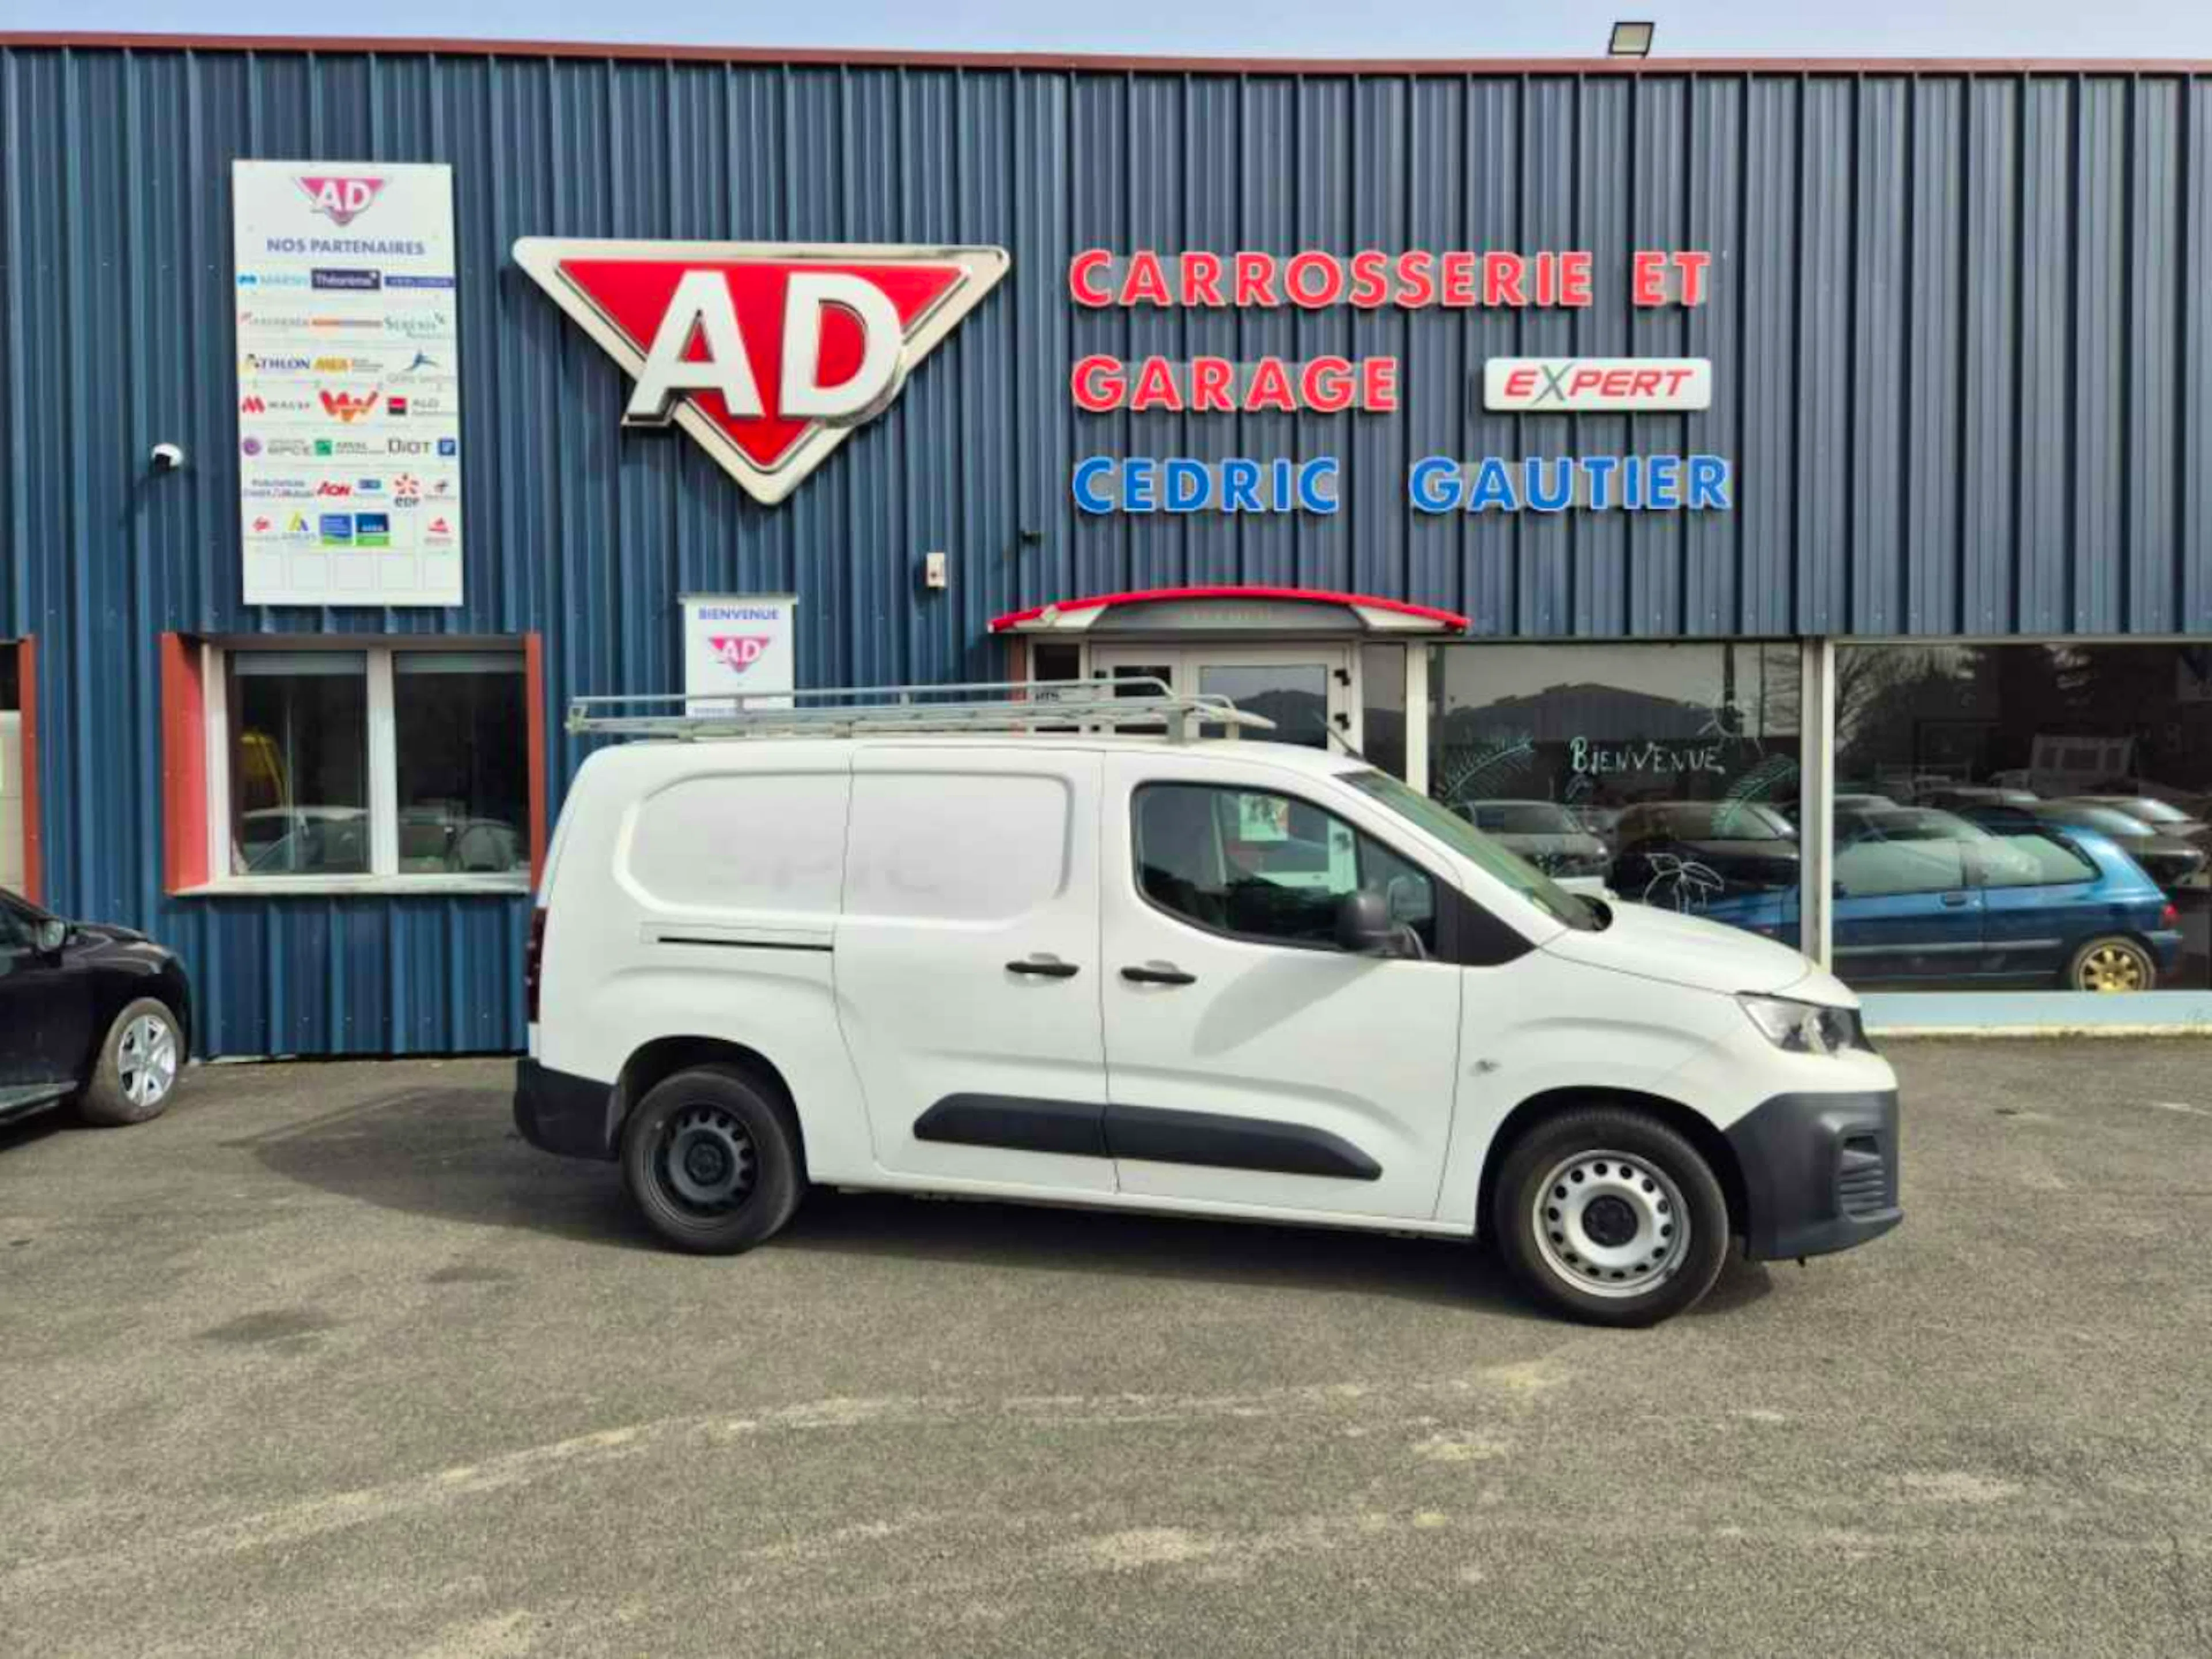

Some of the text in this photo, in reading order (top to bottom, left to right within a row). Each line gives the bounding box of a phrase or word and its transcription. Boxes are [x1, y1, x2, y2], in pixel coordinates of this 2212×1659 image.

[313, 180, 373, 212] AD
[267, 238, 425, 255] NOS PARTENAIRES
[1070, 250, 1711, 308] CARROSSERIE ET
[624, 269, 904, 423] AD
[1071, 357, 1398, 412] GARAGE
[1503, 364, 1694, 402] EXPERT
[1072, 455, 1732, 514] CEDRIC GAUTIER
[699, 608, 779, 620] BIENVENUE
[721, 639, 760, 662] AD
[1569, 736, 1726, 775] BIENVENUE
